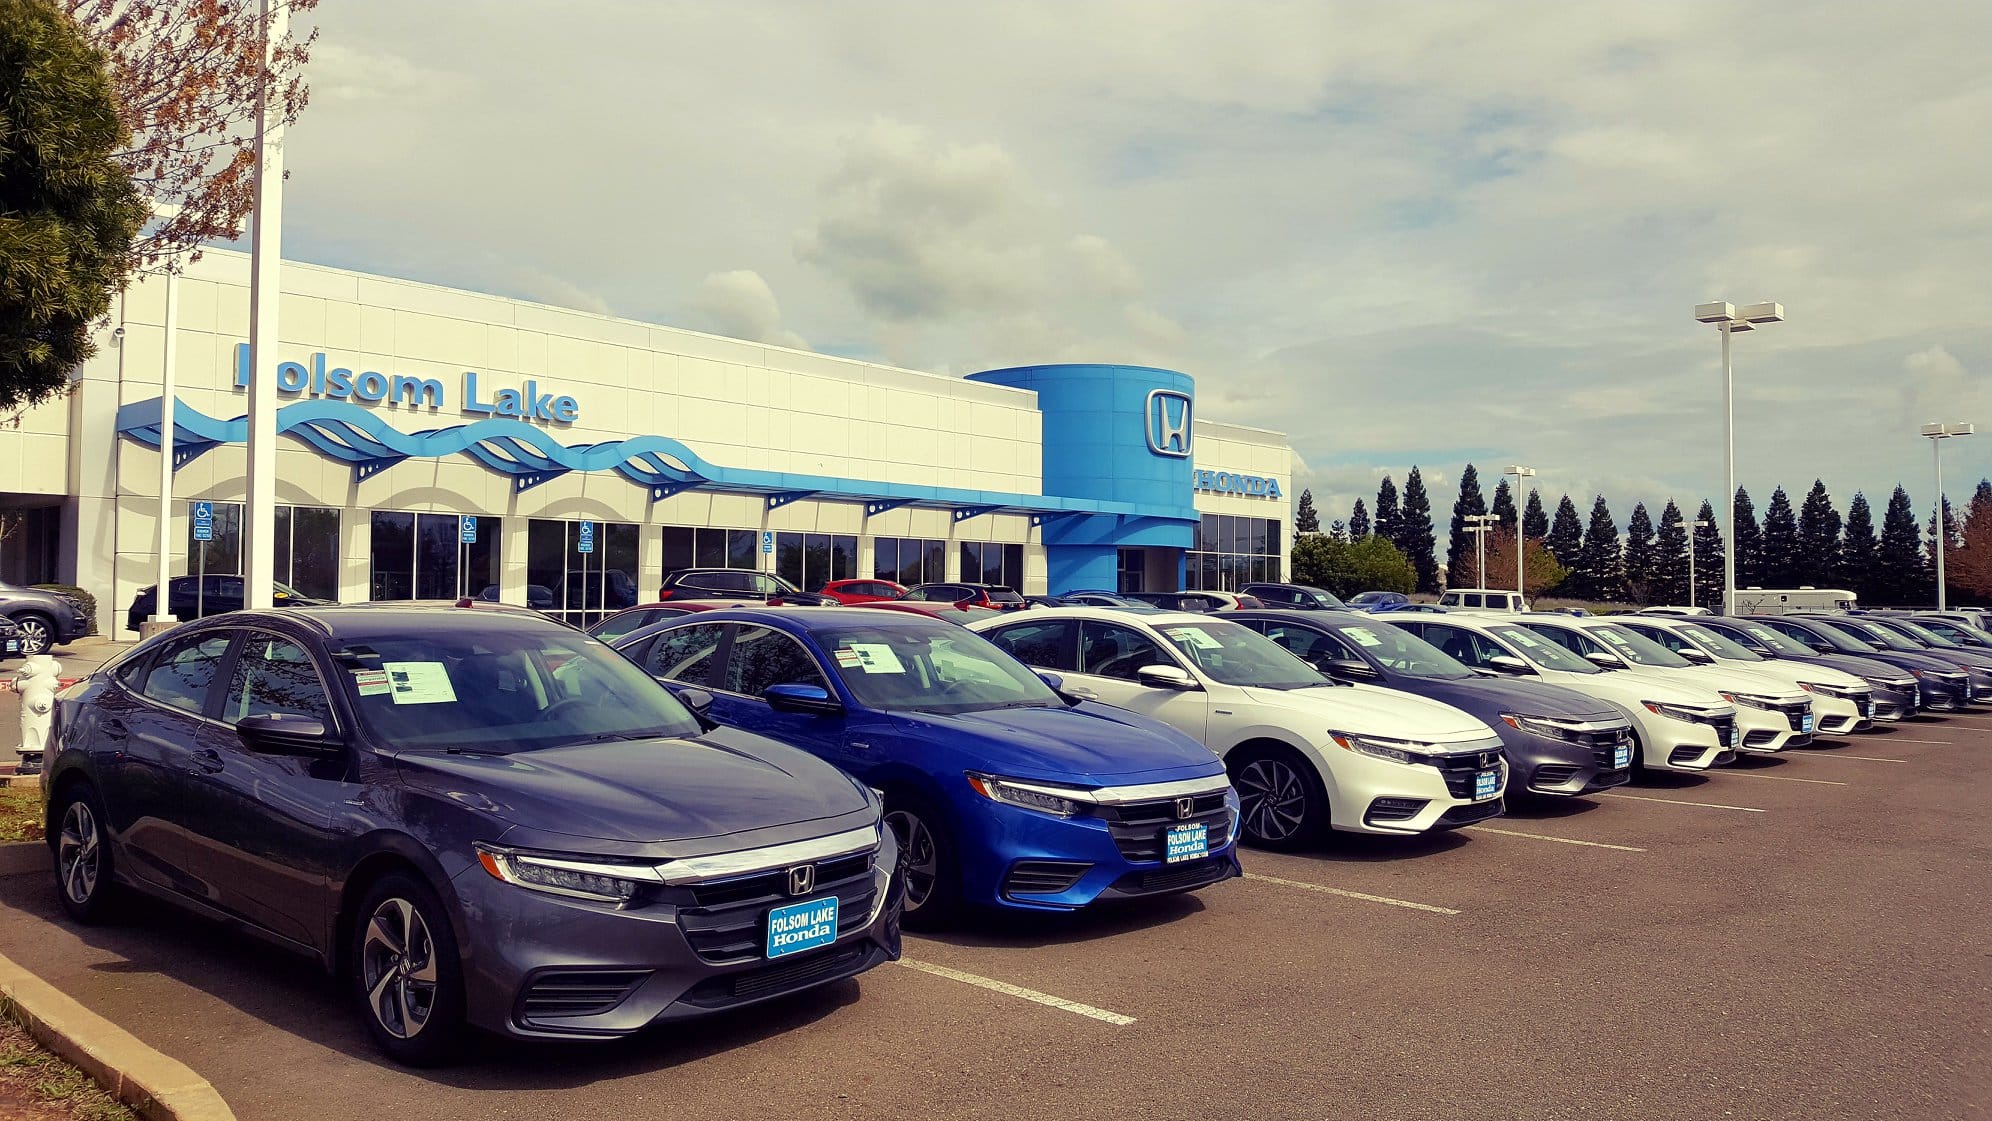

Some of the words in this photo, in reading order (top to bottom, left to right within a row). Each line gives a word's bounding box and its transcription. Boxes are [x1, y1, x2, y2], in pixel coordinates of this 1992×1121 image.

[462, 372, 579, 422] Lake
[1195, 469, 1282, 497] HONDA
[1168, 831, 1191, 846] FOLSOM
[1192, 829, 1207, 841] LAKE
[1169, 841, 1204, 854] Honda
[771, 912, 809, 934] FOLSOM
[810, 907, 834, 925] LAKE
[773, 924, 831, 947] Honda
